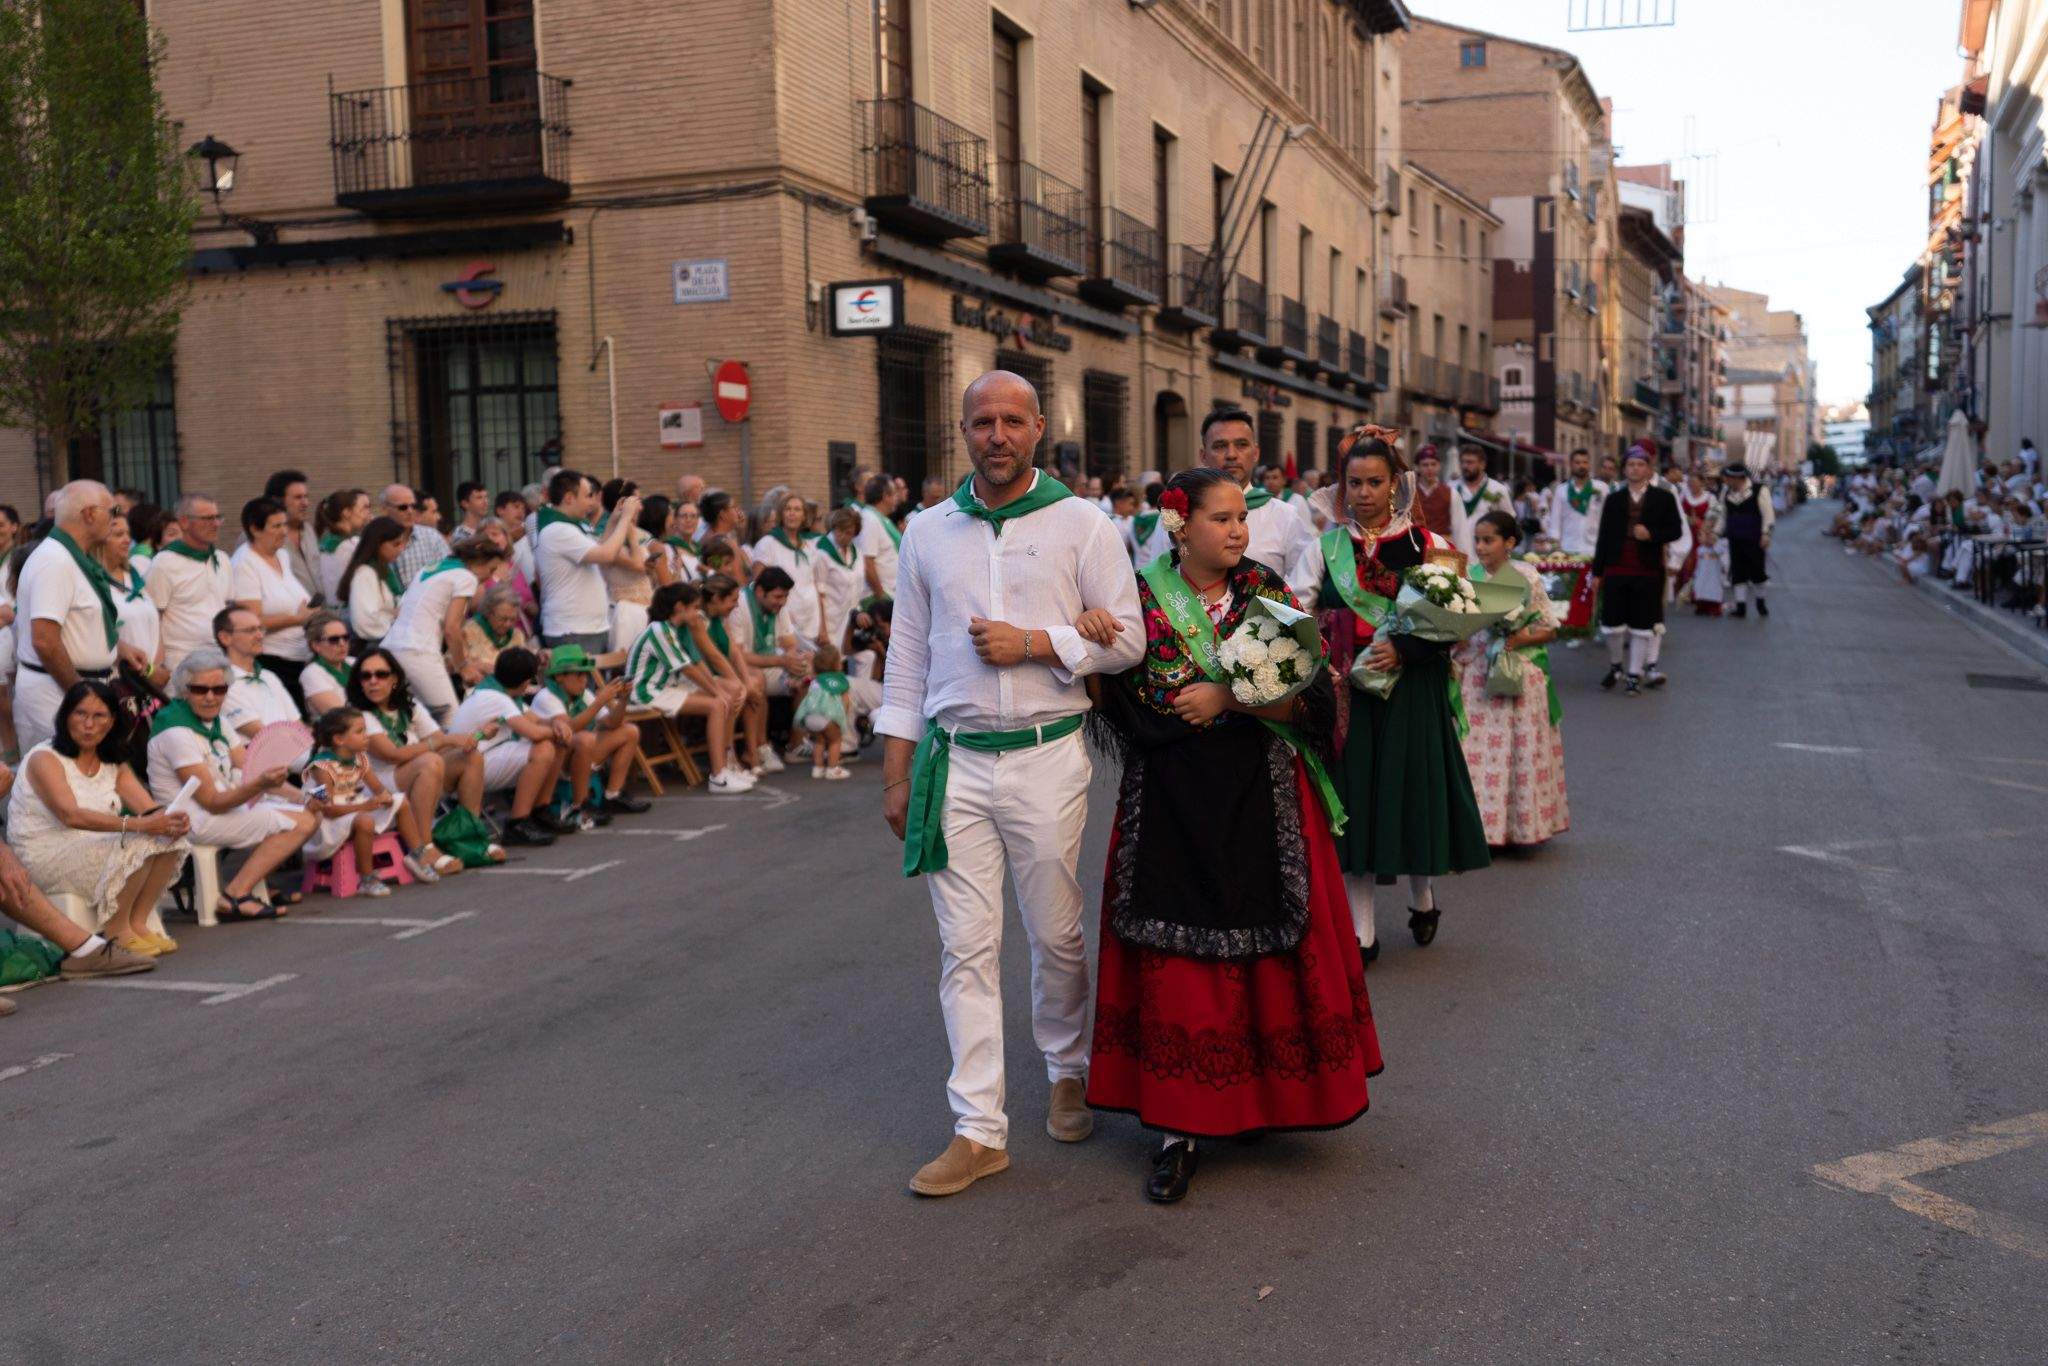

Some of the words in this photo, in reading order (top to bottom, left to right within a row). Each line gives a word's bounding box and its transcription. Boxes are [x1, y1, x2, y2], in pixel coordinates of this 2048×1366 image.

[694, 265, 719, 274] PLAZA
[691, 278, 704, 287] DE
[705, 276, 719, 286] LA
